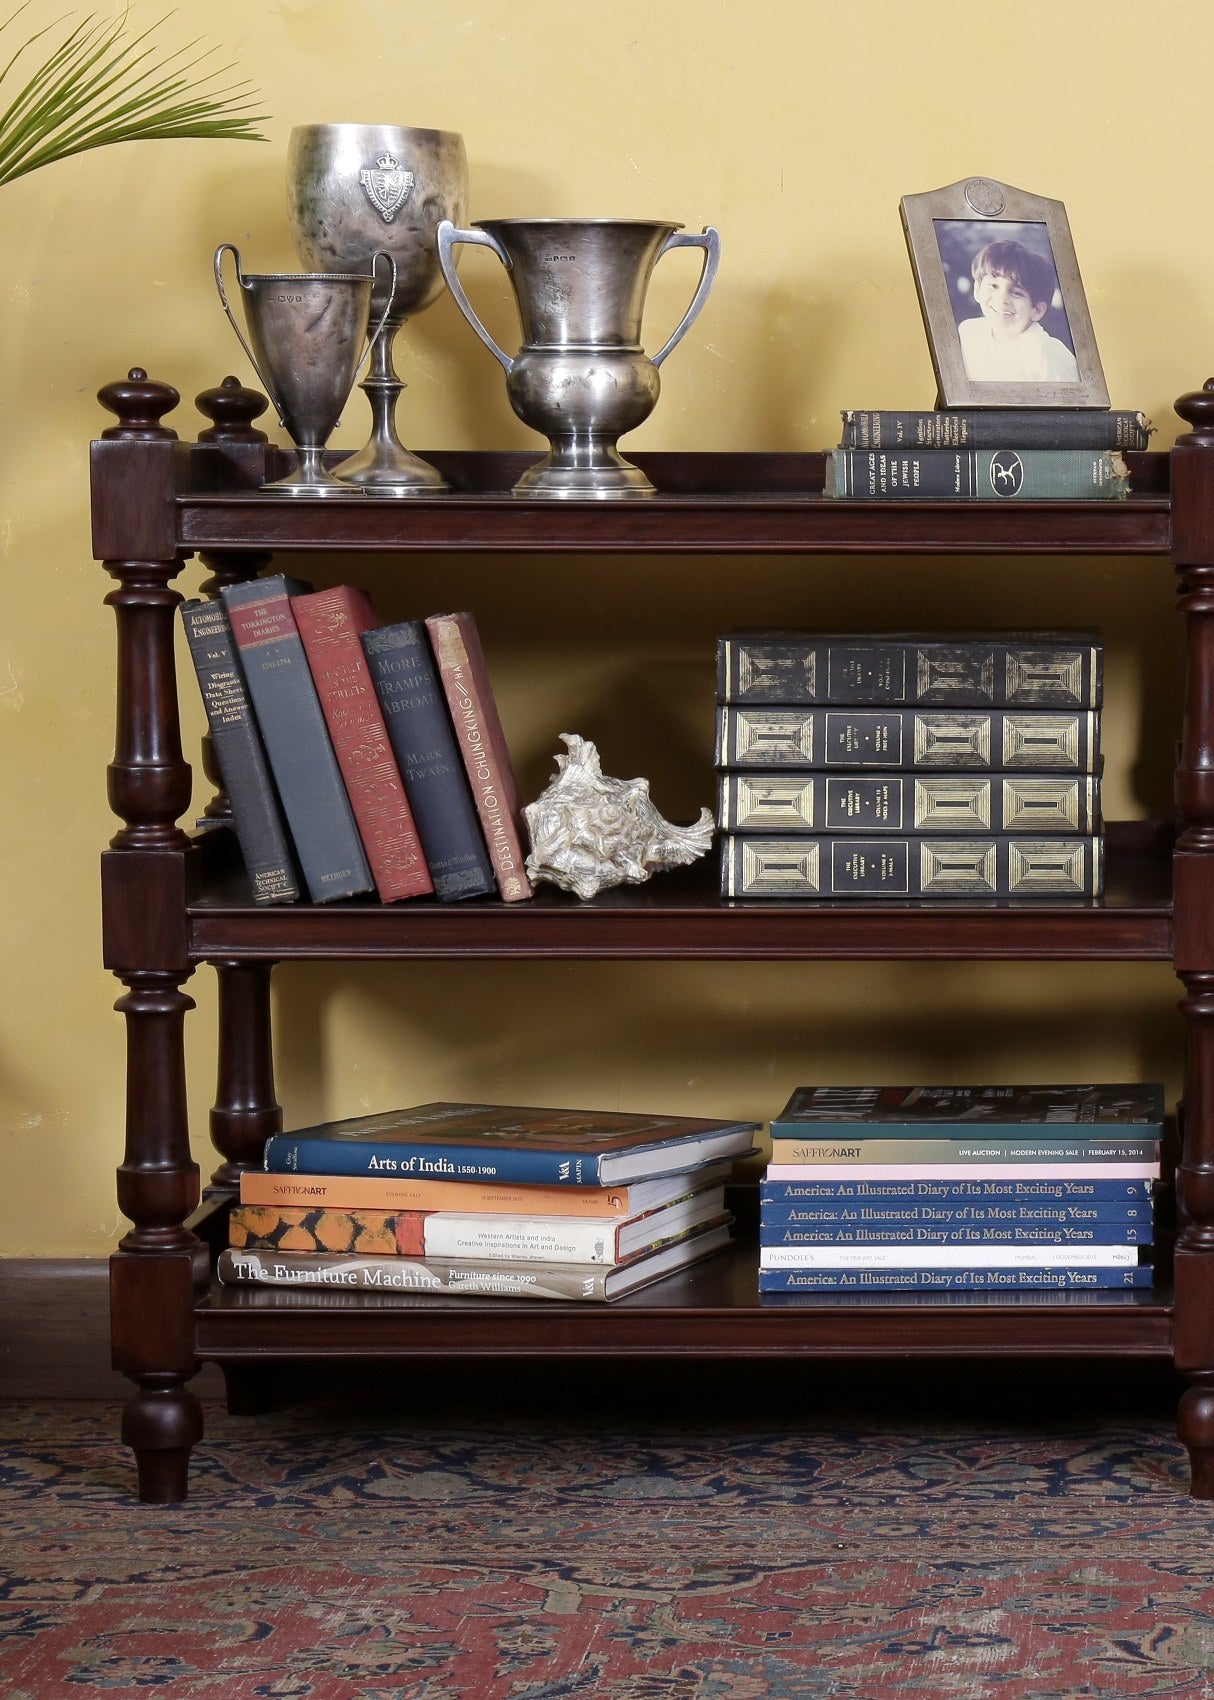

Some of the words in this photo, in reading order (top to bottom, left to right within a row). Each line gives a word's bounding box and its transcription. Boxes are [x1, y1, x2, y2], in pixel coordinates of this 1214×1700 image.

[897, 420, 902, 429] IV
[891, 477, 898, 487] OF
[253, 608, 267, 618] THE
[242, 613, 287, 630] TORRINGTON
[253, 625, 281, 638] DIARIES
[207, 651, 221, 659] Vol.
[377, 656, 421, 676] MORE
[211, 671, 235, 680] Wiring
[377, 674, 432, 696] TRAMPS
[211, 696, 245, 708] Questions
[383, 693, 438, 715] ABROAD
[210, 708, 222, 717] and
[222, 714, 242, 723] Index
[459, 698, 490, 780] CHUNGKING
[405, 749, 443, 766] MARK
[406, 764, 450, 781] TWAIN
[481, 785, 515, 871] DESTINATION
[255, 869, 285, 880] AMERICAN
[255, 875, 288, 887] TECHNICAL
[320, 870, 352, 883] METHUEN
[258, 882, 287, 892] SOCIETY
[285, 1152, 293, 1165] Guy
[792, 1148, 862, 1158] SAFFRONART
[368, 1155, 397, 1172] Arts
[401, 1156, 415, 1171] of
[418, 1157, 455, 1174] India
[559, 1160, 570, 1182] V&A
[273, 1185, 327, 1196] SAFFRONART
[784, 1185, 834, 1197] America:
[836, 1185, 853, 1196] An
[856, 1184, 915, 1196] Illustrated
[917, 1184, 949, 1198] Diary
[952, 1184, 965, 1195] of
[967, 1184, 981, 1195] Its
[983, 1184, 1013, 1194] Most
[1015, 1183, 1063, 1197] Exciting
[1064, 1183, 1094, 1194] Years
[1127, 1186, 1138, 1195] 9
[478, 1232, 504, 1241] Western
[504, 1233, 526, 1241] Artists
[527, 1234, 539, 1242] and
[540, 1234, 556, 1242] India
[457, 1240, 483, 1248] Creative
[484, 1240, 521, 1250] Inspirations
[541, 1243, 553, 1251] and
[554, 1244, 576, 1252] Design
[234, 1262, 269, 1281] The
[274, 1264, 359, 1285] Furniture
[363, 1269, 442, 1289] Machine
[448, 1269, 491, 1282] Furniture
[492, 1271, 515, 1283] since
[516, 1274, 537, 1284] 1990
[448, 1281, 481, 1291] Gareth
[483, 1282, 521, 1293] Williams
[582, 1277, 595, 1297] V&A
